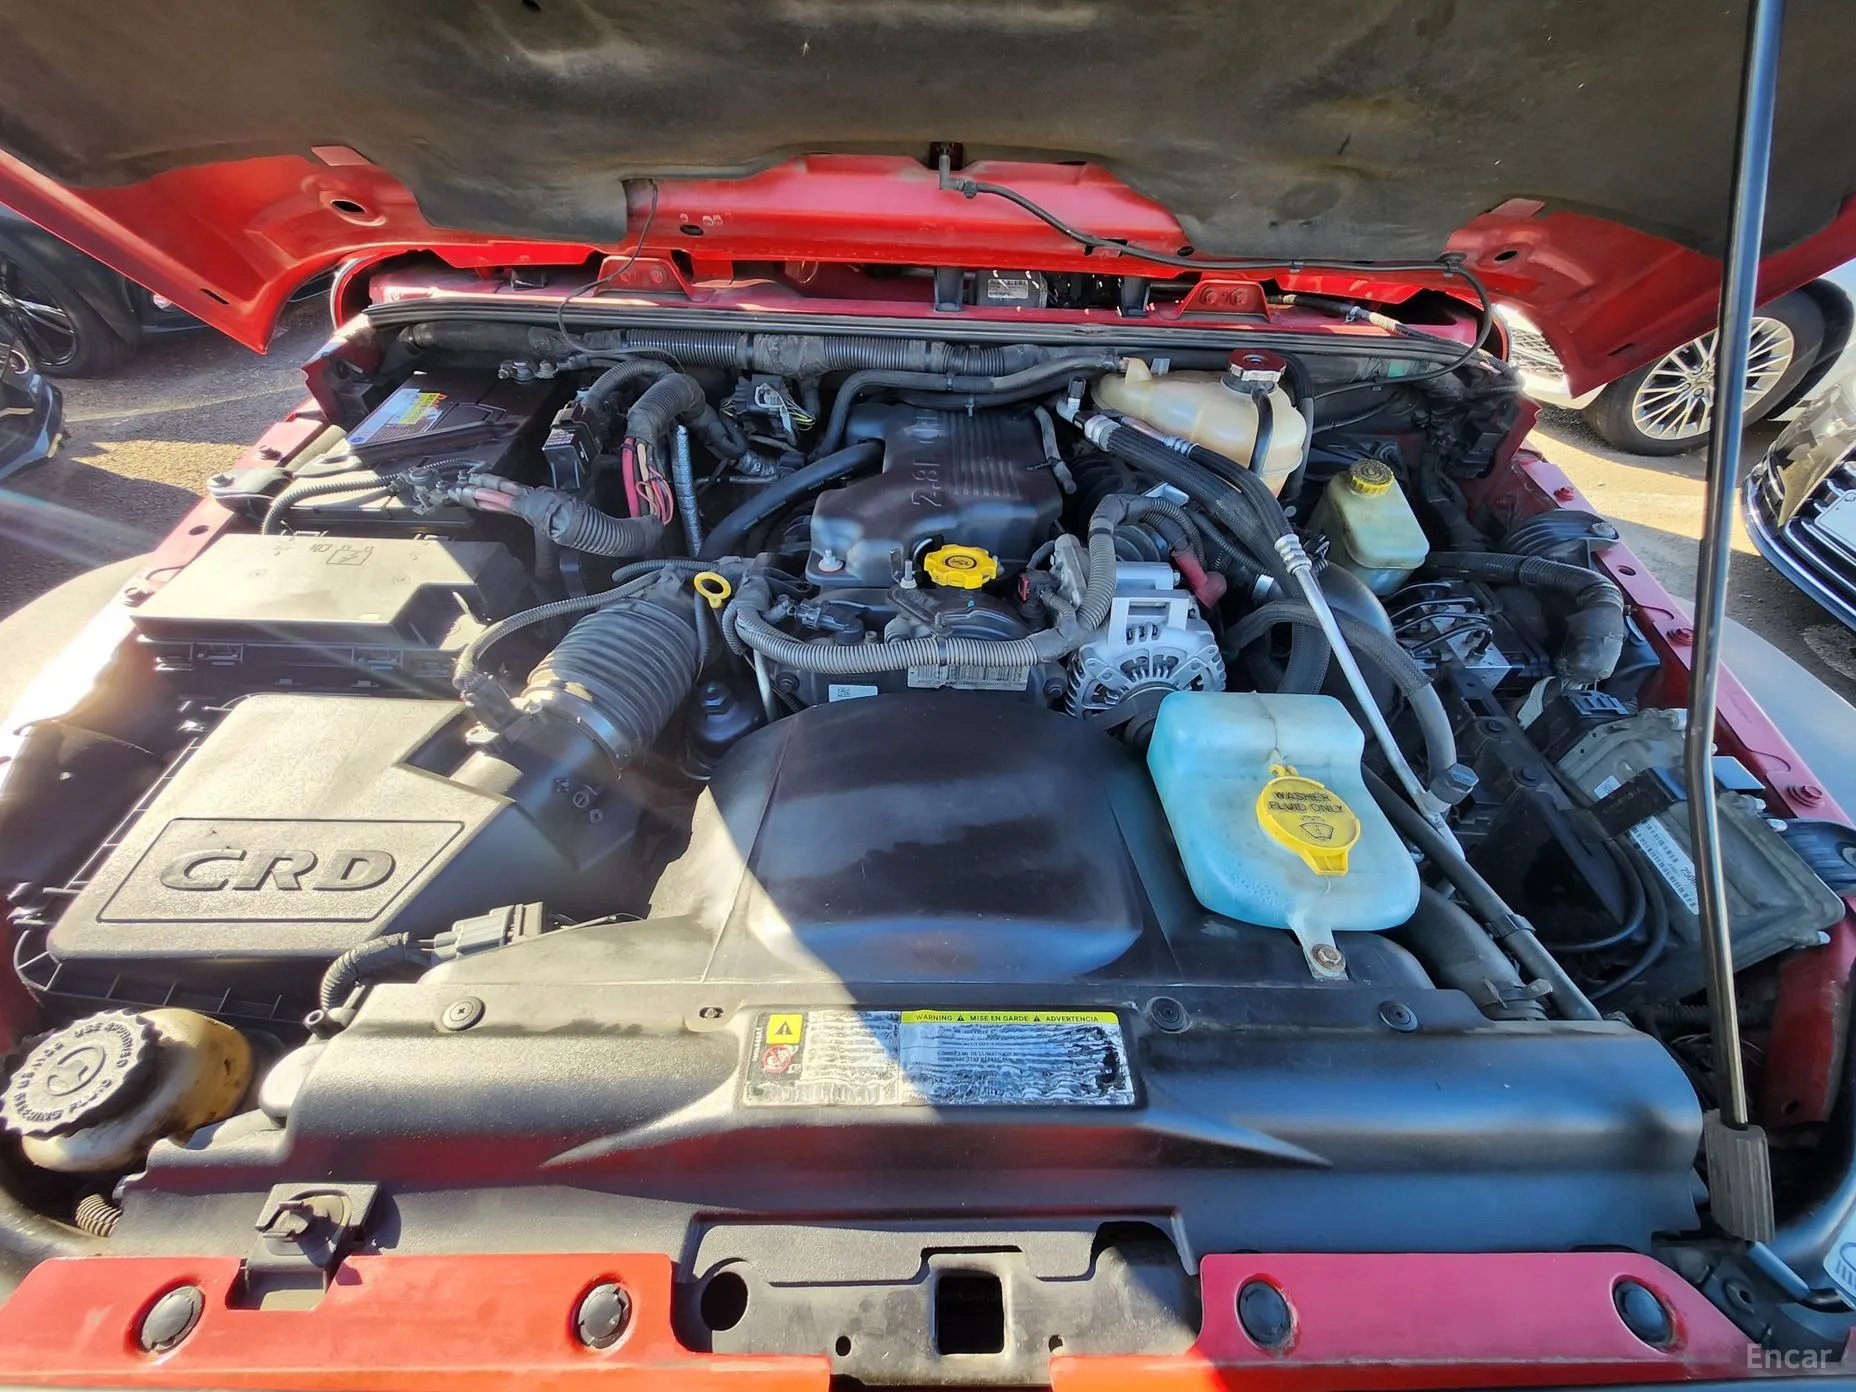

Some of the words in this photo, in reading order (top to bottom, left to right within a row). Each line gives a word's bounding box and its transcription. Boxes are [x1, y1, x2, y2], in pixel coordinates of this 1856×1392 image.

[1274, 791, 1331, 802] WASHER
[1269, 800, 1307, 811] FLUID
[1311, 804, 1344, 813] ONLY
[159, 847, 397, 892] CRD
[915, 1013, 953, 1021] WARNING
